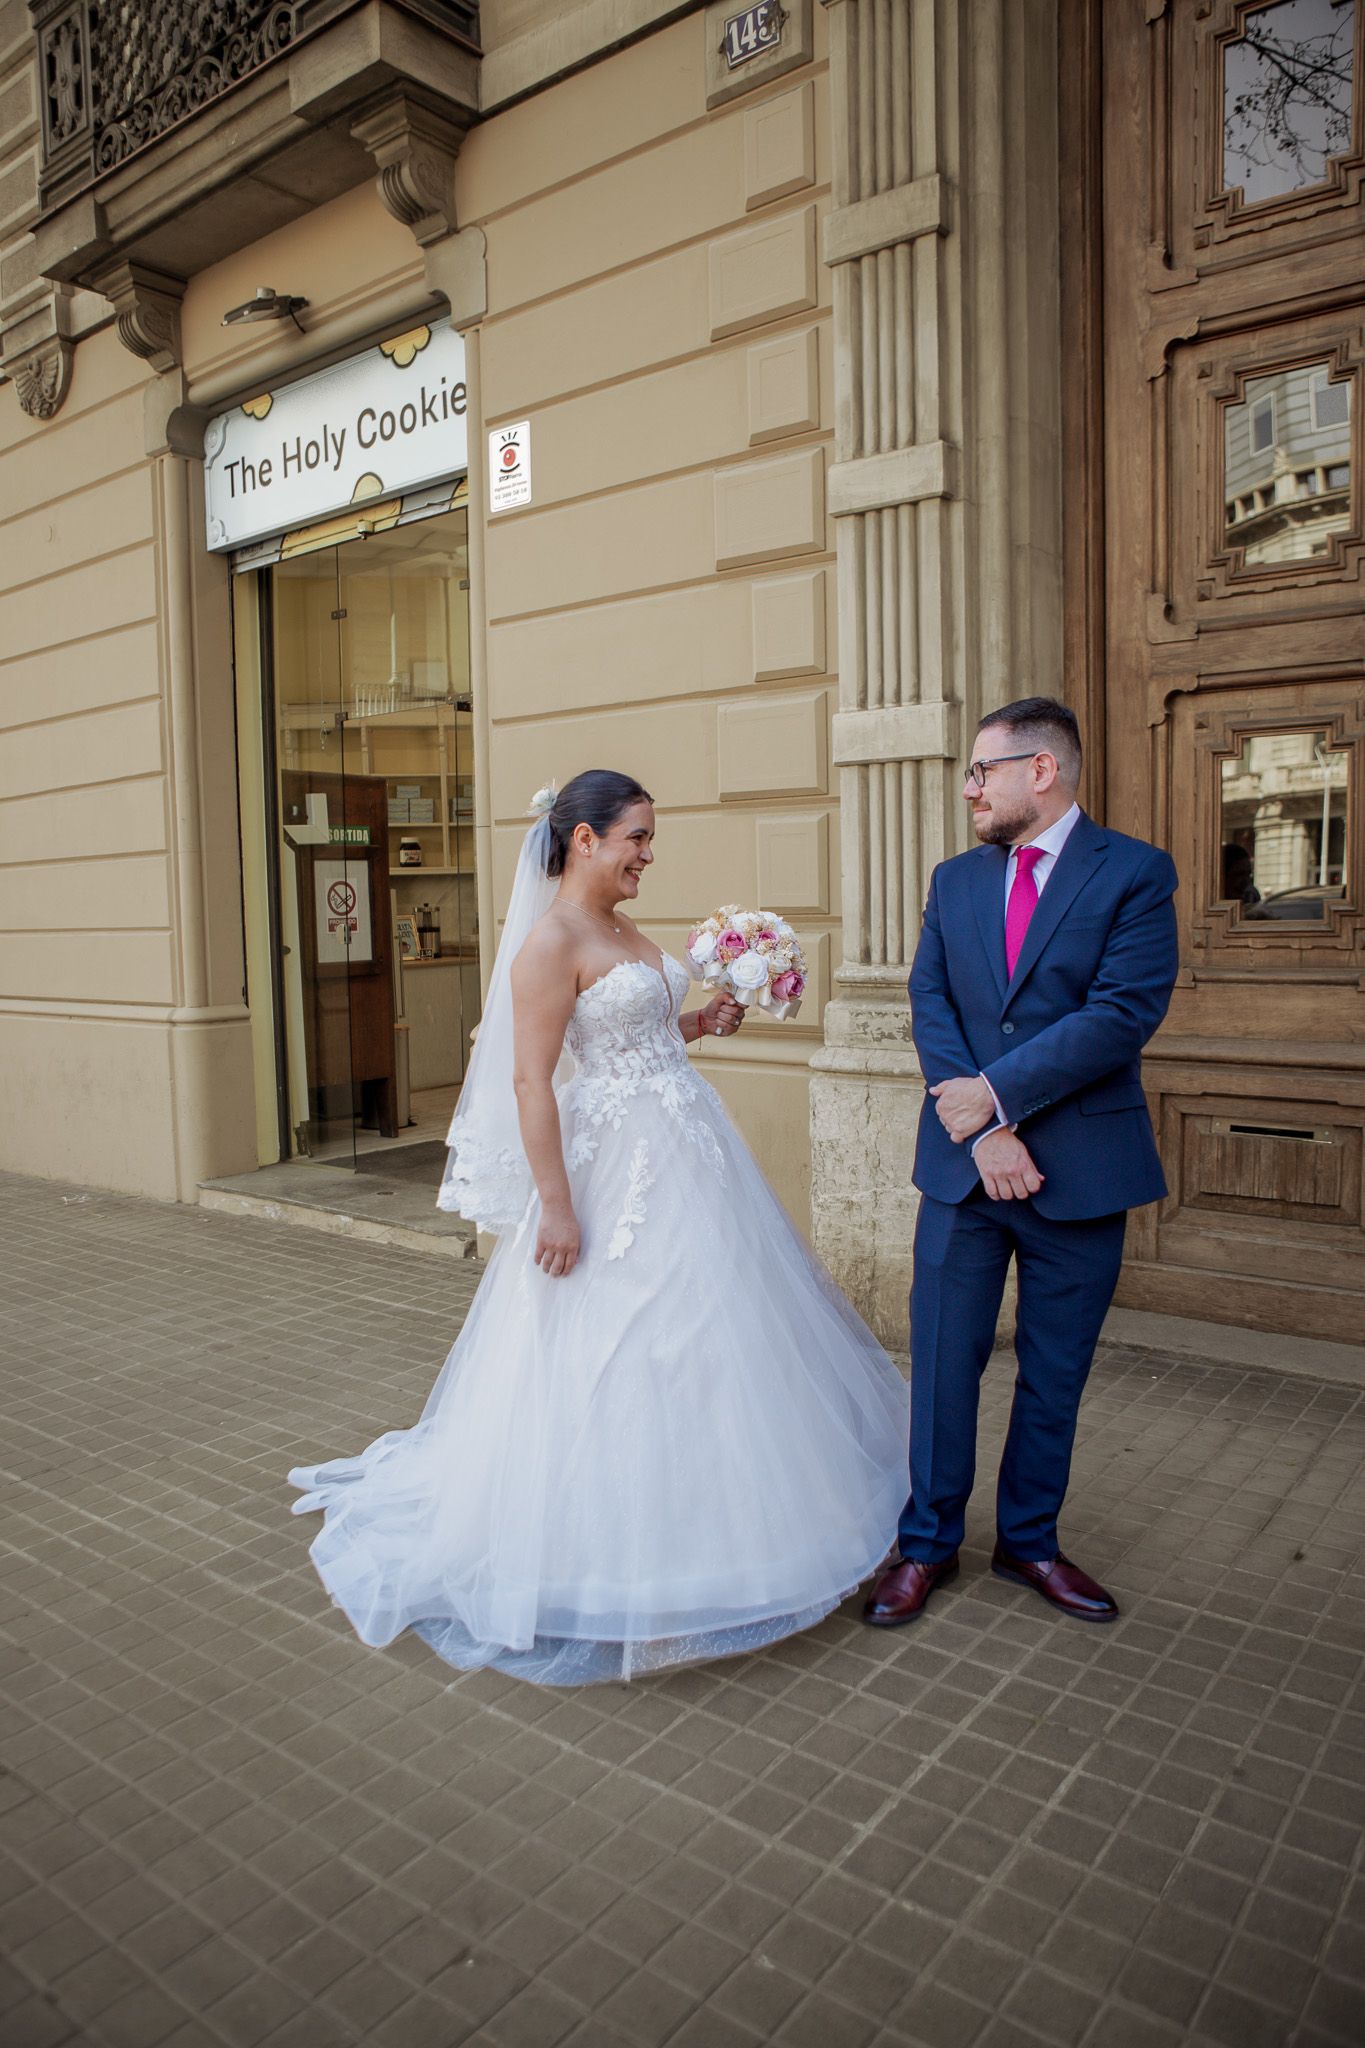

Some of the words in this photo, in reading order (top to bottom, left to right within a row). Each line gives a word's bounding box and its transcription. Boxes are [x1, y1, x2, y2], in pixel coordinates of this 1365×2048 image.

[224, 456, 272, 498] The
[281, 424, 346, 478] Holy
[357, 376, 467, 448] Cookie
[329, 829, 369, 842] SORTIDA
